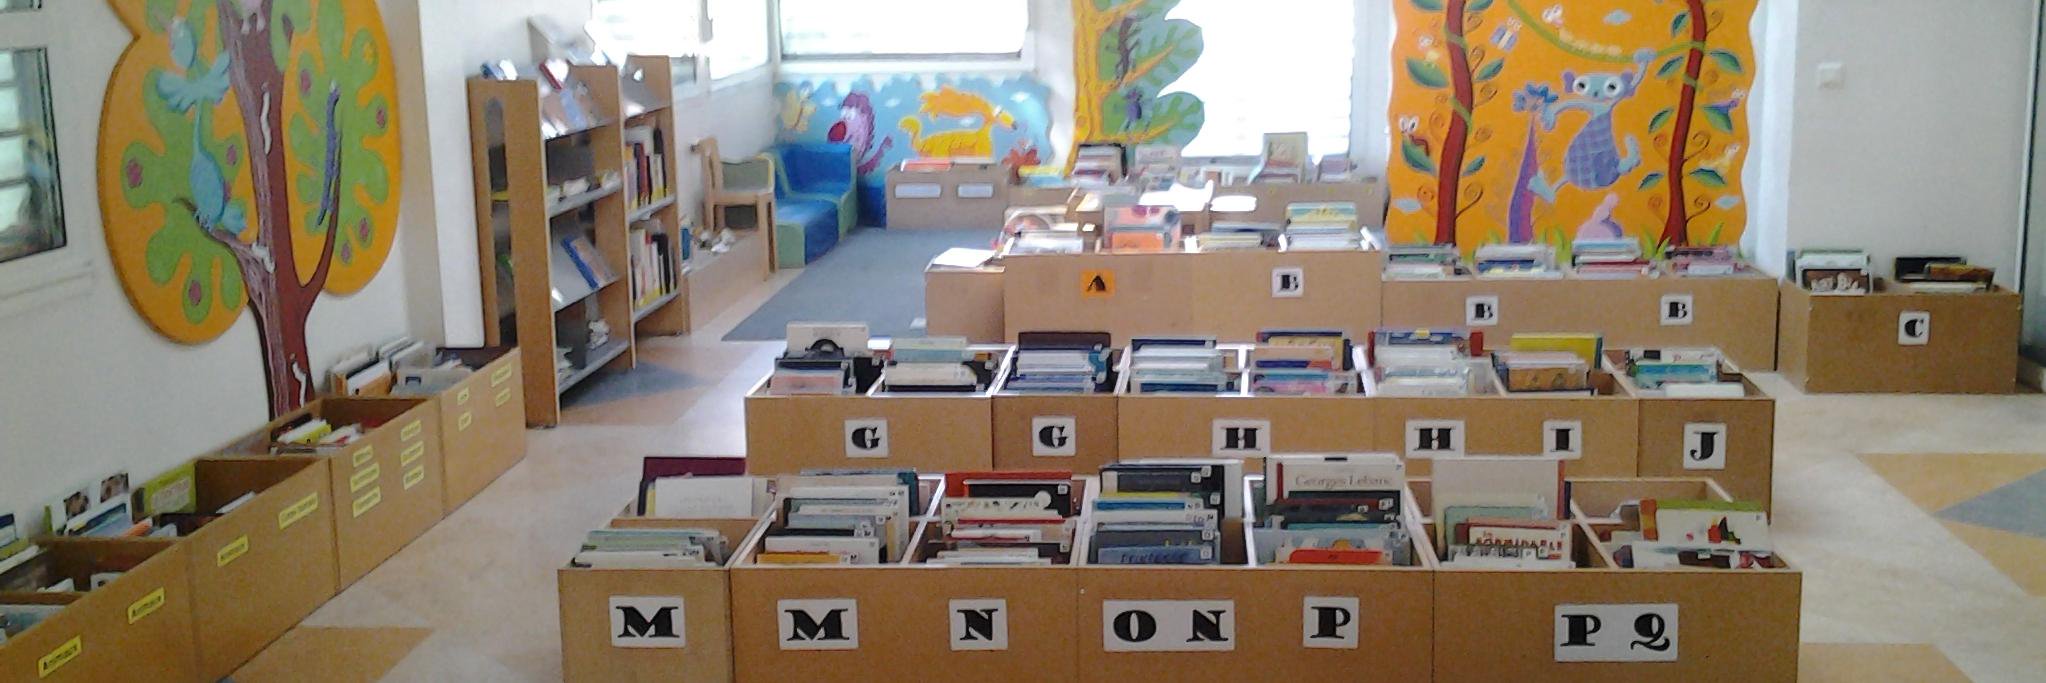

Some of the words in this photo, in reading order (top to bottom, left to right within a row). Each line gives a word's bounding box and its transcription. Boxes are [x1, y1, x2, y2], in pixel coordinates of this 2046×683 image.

[1087, 275, 1106, 291] A
[1279, 274, 1299, 291] B
[1472, 302, 1494, 319] B
[1666, 301, 1688, 318] B
[1904, 318, 1924, 338] C
[851, 426, 881, 450] G
[1038, 425, 1068, 449] G
[1220, 426, 1262, 450] H
[1413, 427, 1456, 451] H
[1550, 428, 1574, 452] I
[1689, 431, 1718, 461] J
[615, 605, 681, 639] M
[784, 608, 850, 642] M
[957, 608, 999, 641] N
[1113, 609, 1157, 643] O
[1185, 609, 1229, 643] N
[1310, 606, 1351, 640] P
[1560, 614, 1601, 647] P
[1630, 612, 1671, 652] Q
